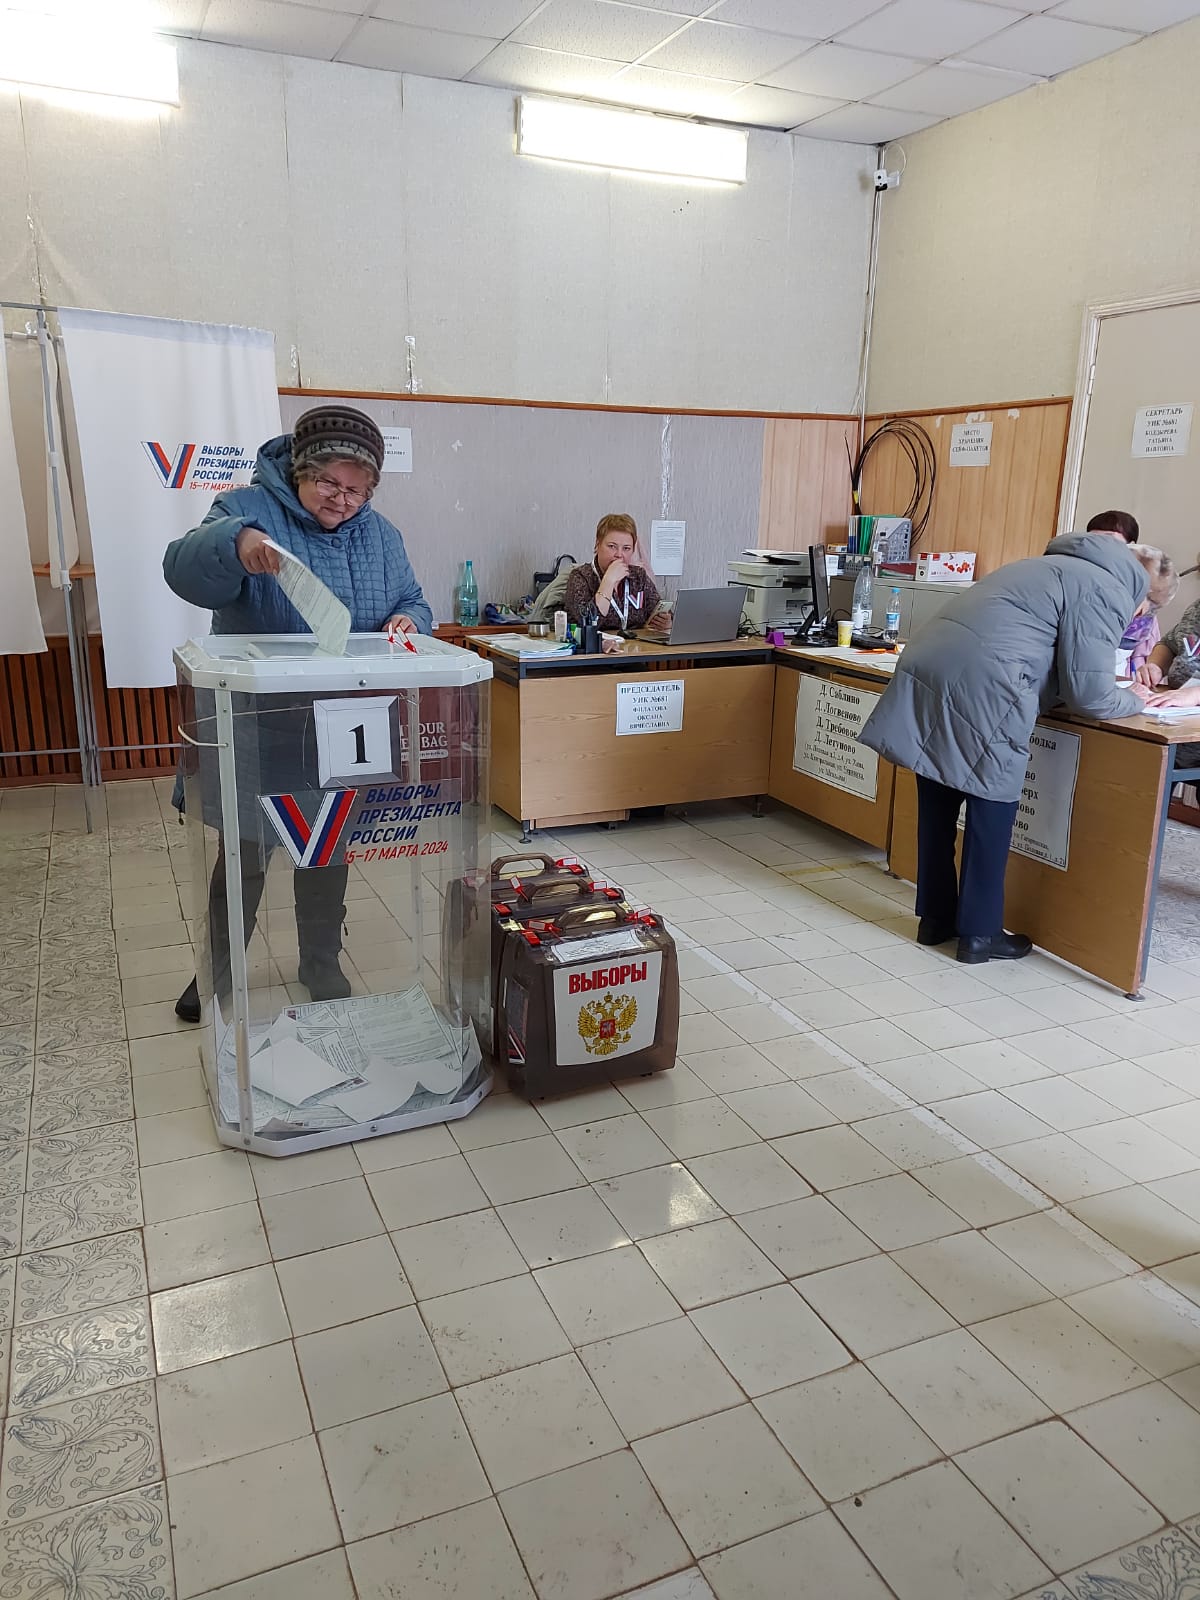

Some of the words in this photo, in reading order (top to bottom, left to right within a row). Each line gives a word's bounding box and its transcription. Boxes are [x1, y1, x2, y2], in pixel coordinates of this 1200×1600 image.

[1145, 407, 1183, 417] СЕКРЕТАРЬ
[201, 445, 245, 457] ВЫБОРЫ
[192, 469, 233, 481] РОССИИ
[621, 684, 680, 695] ПРЕДСЕДАТЕЛЬ
[829, 686, 861, 705] Саблино
[632, 696, 649, 704] УИК
[637, 713, 663, 721] ОКСАНА
[417, 722, 446, 735] OUR
[347, 723, 372, 765] 1
[421, 735, 449, 748] BAG
[1029, 732, 1057, 751] бодка
[364, 783, 441, 804] ВЫБОРЫ
[357, 800, 462, 825] ПРЕЗИДЕНТА
[348, 825, 418, 846] РОССИИ
[379, 844, 419, 860] МАРТА
[420, 841, 449, 856] 2024
[568, 961, 648, 995] ВЫБОРЫ
